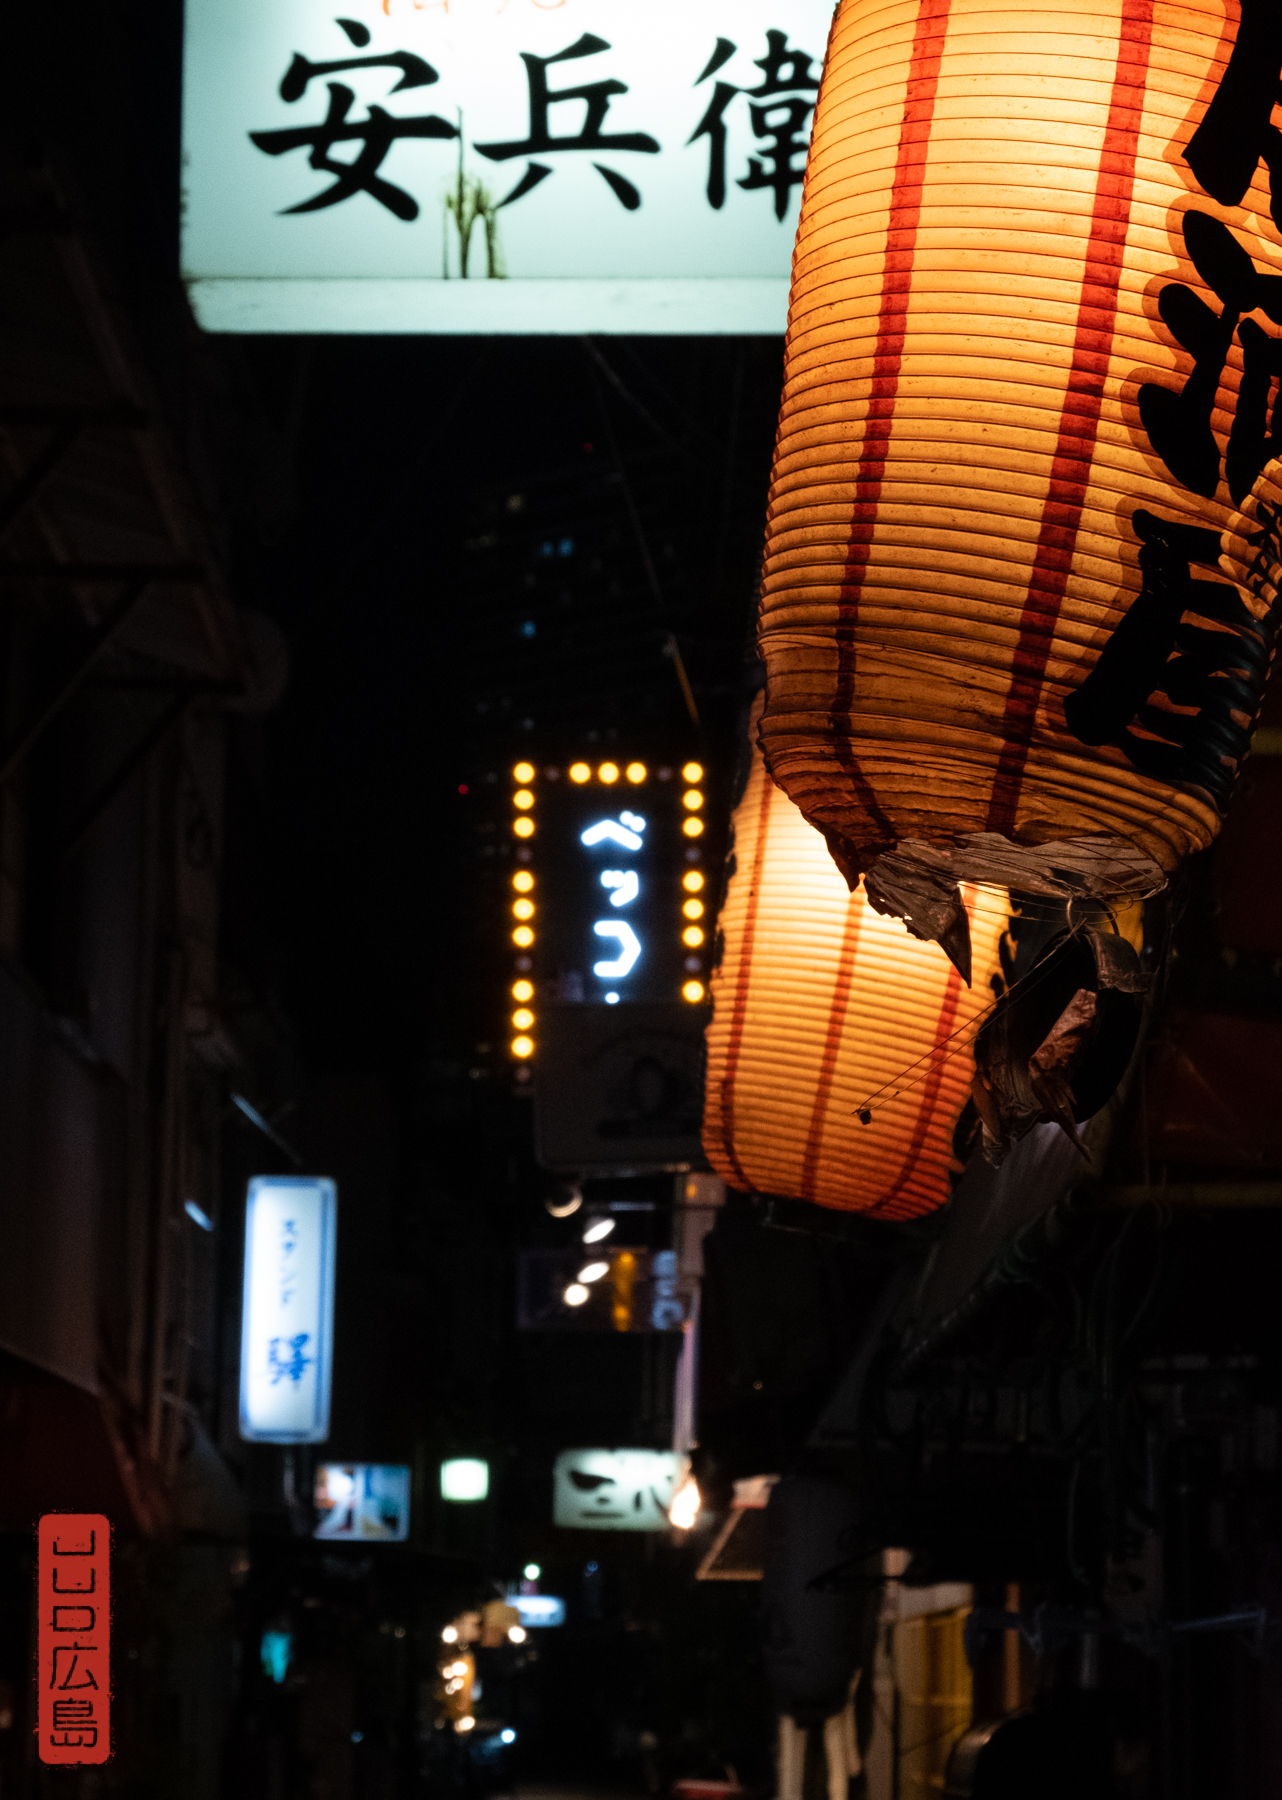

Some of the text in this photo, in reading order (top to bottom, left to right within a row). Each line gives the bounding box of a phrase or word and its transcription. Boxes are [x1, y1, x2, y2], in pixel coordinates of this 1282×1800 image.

[247, 18, 824, 222] 安兵衛
[580, 810, 646, 1004] ベッコ
